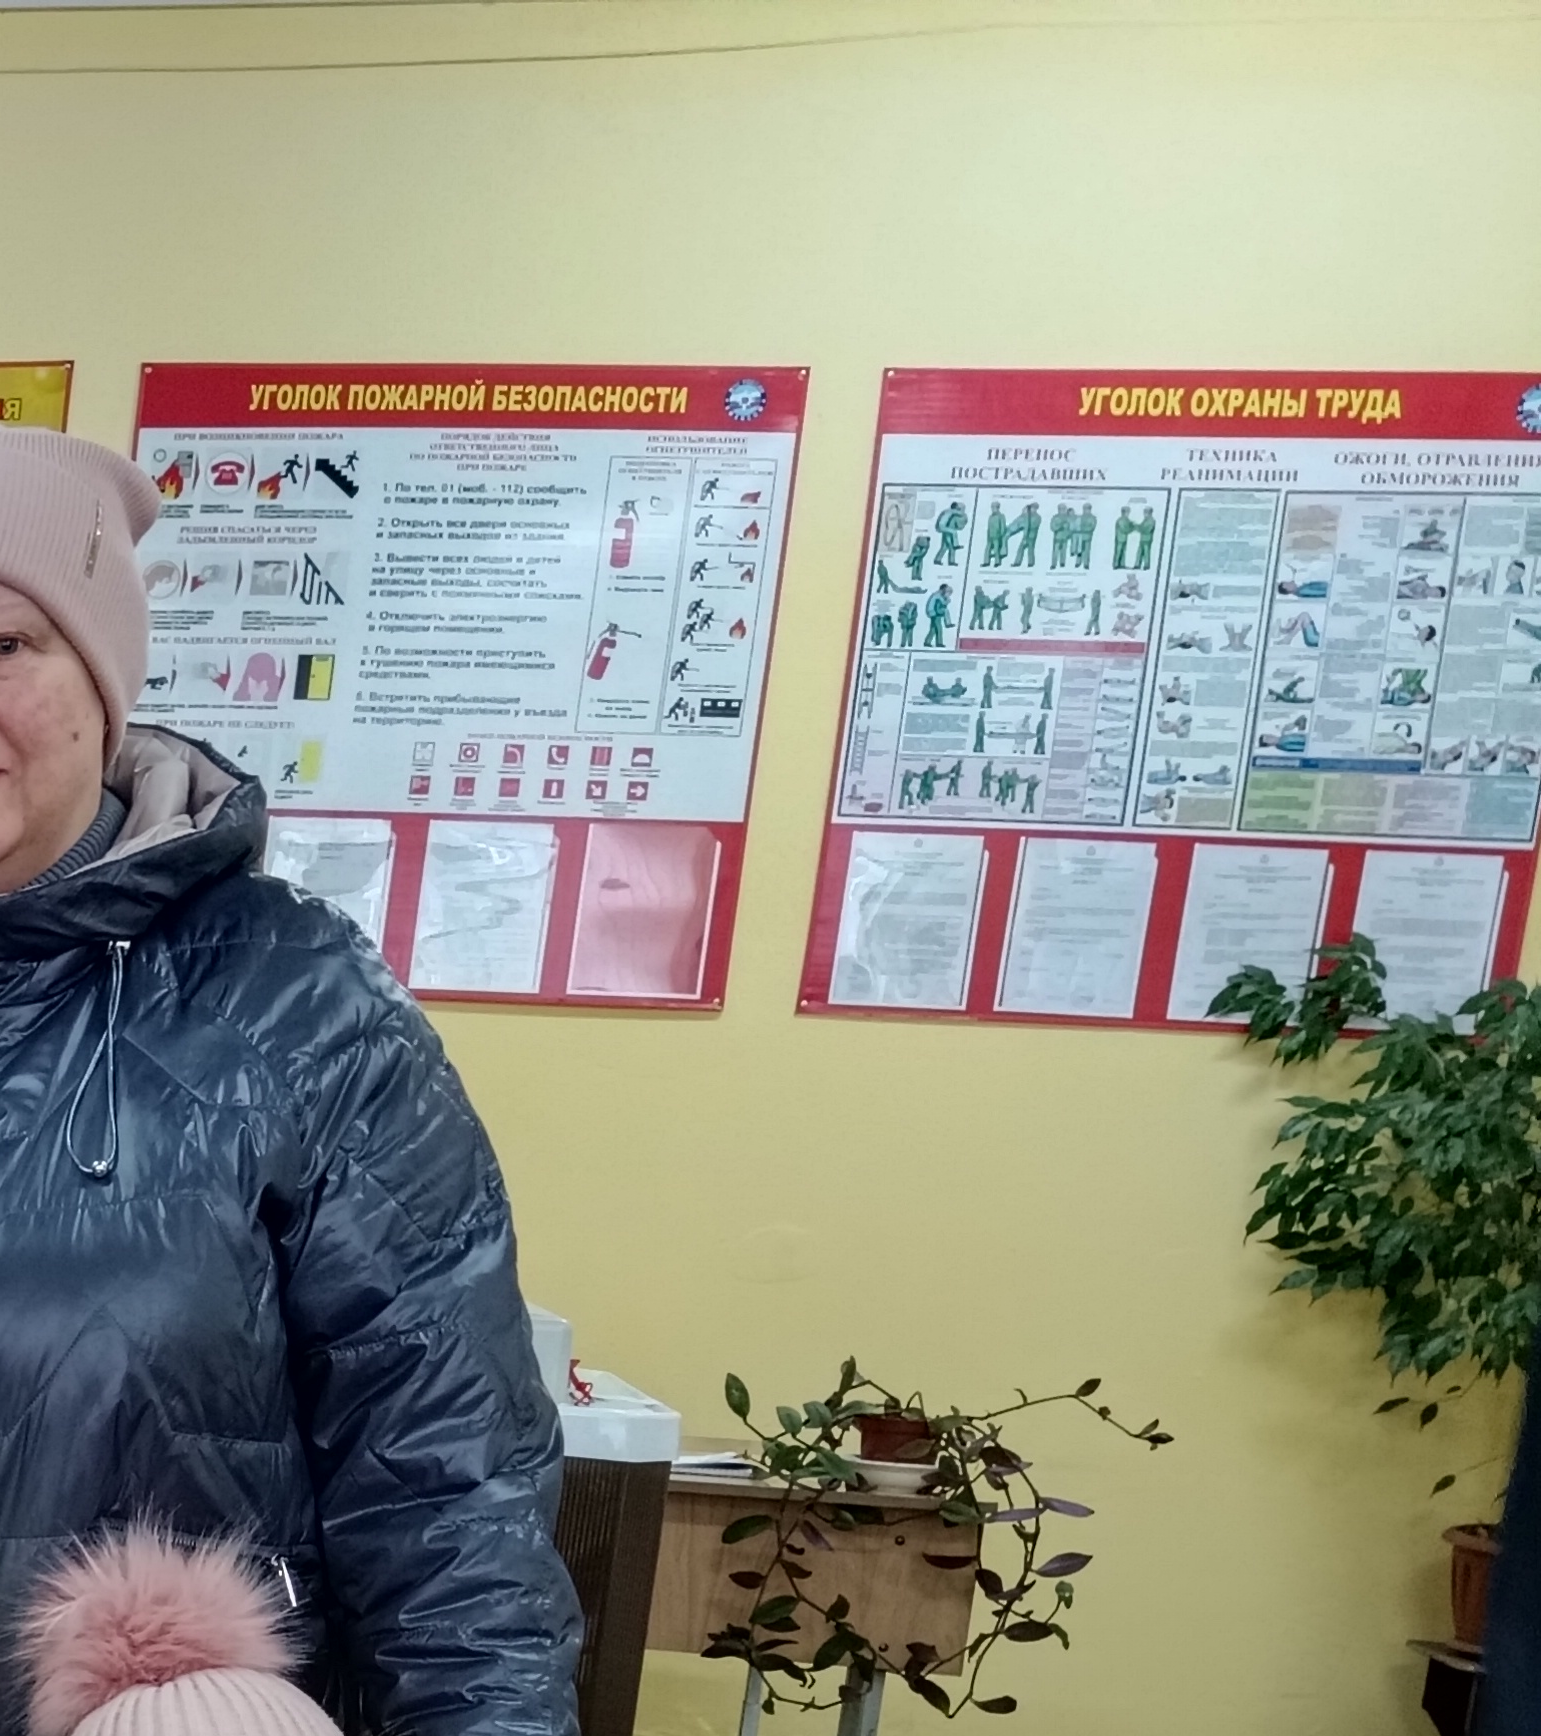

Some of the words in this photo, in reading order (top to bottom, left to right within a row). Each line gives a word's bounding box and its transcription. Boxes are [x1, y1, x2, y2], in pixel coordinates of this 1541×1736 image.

[249, 383, 342, 411] УГОЛОК
[347, 379, 486, 412] ПОЖАРНОЙ
[491, 386, 689, 414] БЕЗОПАСНОСТИ
[1078, 386, 1185, 416] УГОЛОК
[1190, 388, 1308, 418] ОХРАНЫ
[1315, 389, 1401, 424] ТРУДА
[986, 447, 1076, 462] ПЕРЕНОС
[1187, 449, 1278, 463] ТЕХНИКА
[1334, 451, 1412, 467] ОЖОГИ,
[950, 466, 1107, 482] ПОСТРАДАВШИХ
[1160, 467, 1300, 483] РЕАНИМАЦИИ
[1360, 472, 1520, 487] ОБМОРОЖЕНИЯ
[383, 483, 392, 493] 1.
[395, 482, 412, 493] По
[415, 484, 437, 493] тел.
[441, 483, 454, 493] 01
[526, 484, 587, 495] сообщить
[394, 497, 438, 506] пожаре
[452, 497, 514, 507] пожарную
[391, 517, 443, 530] Открыть
[469, 520, 507, 530] двери
[387, 531, 444, 539] запасных
